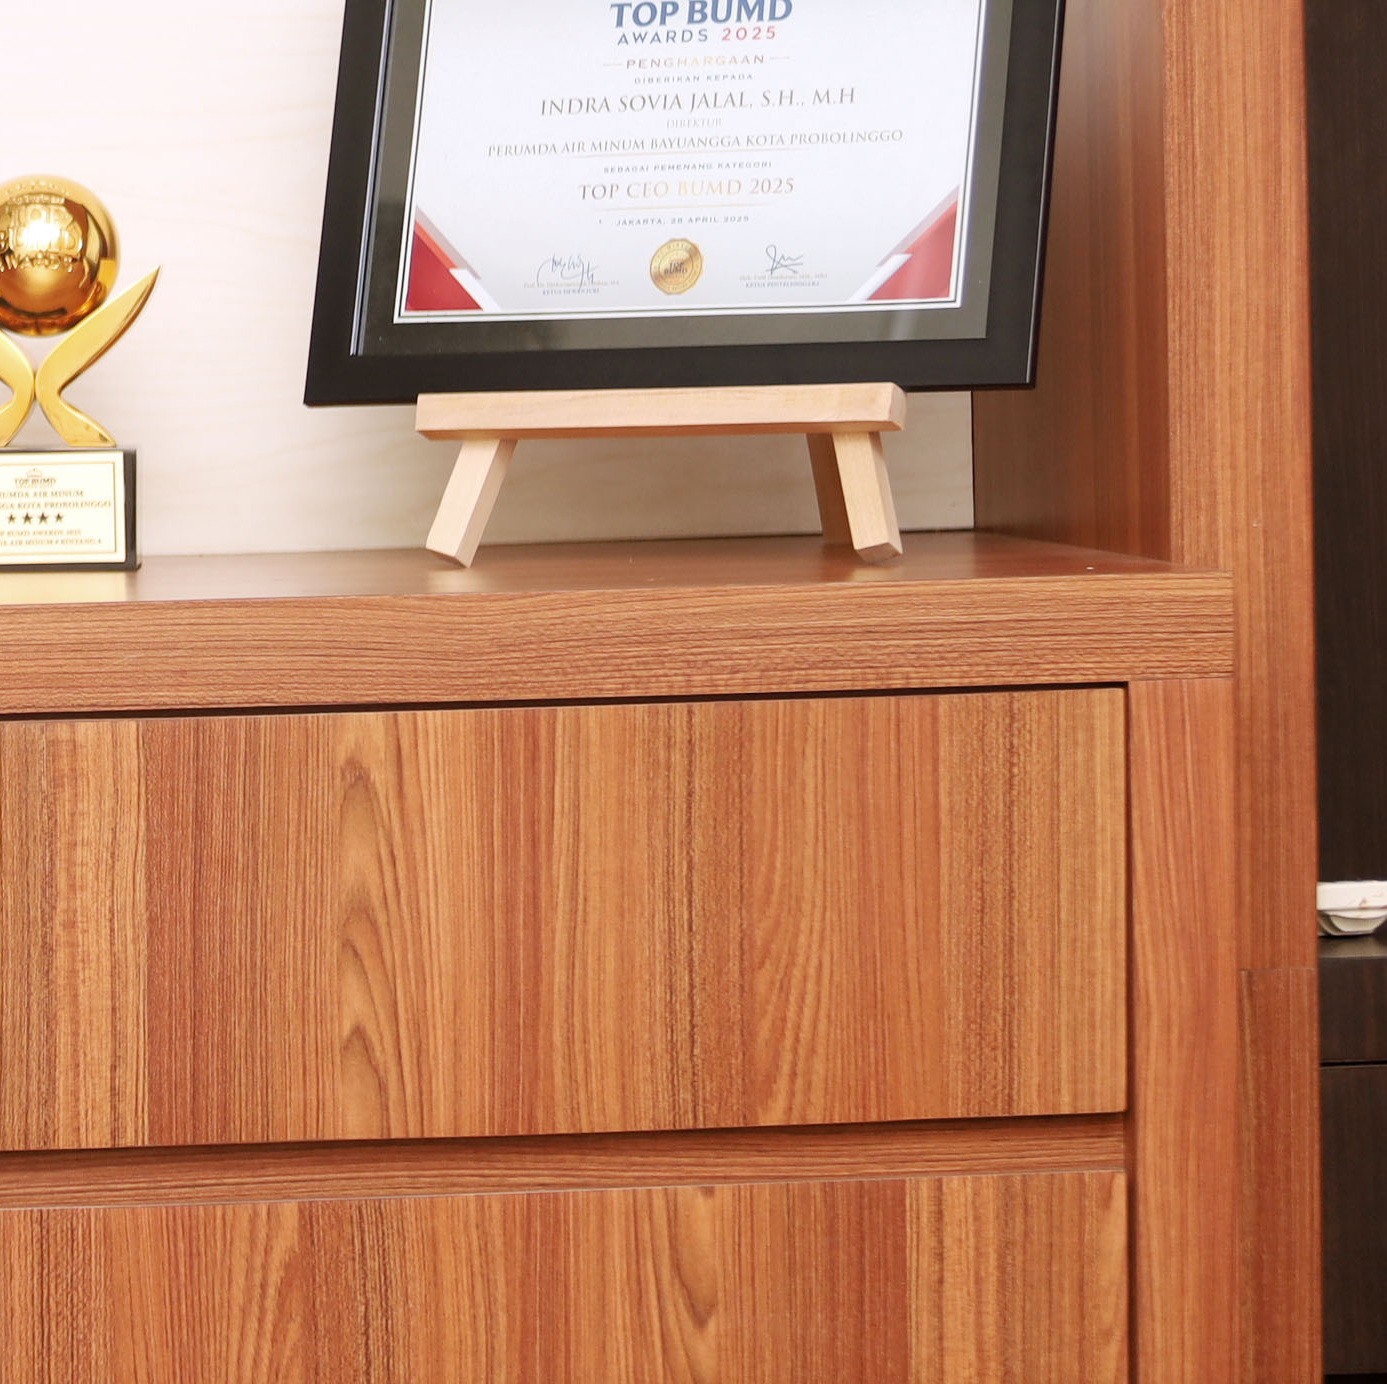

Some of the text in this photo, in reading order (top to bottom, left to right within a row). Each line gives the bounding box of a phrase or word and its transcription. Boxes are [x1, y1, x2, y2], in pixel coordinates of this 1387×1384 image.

[611, 1, 679, 27] TOP
[617, 26, 776, 45] AWARDS 2025
[627, 54, 764, 69] PENGHARGAAN
[541, 96, 610, 116] INDRA
[619, 93, 682, 113] SOVIA
[691, 92, 753, 112] JALAL,
[812, 87, 855, 105] M.H
[667, 118, 722, 129] DIREKTUR
[488, 129, 903, 157] PERUMDA AIR MINUM BAYUANGGA KOTA PROBOLINGGO
[580, 177, 795, 200] TOP CEO BUMD 2025
